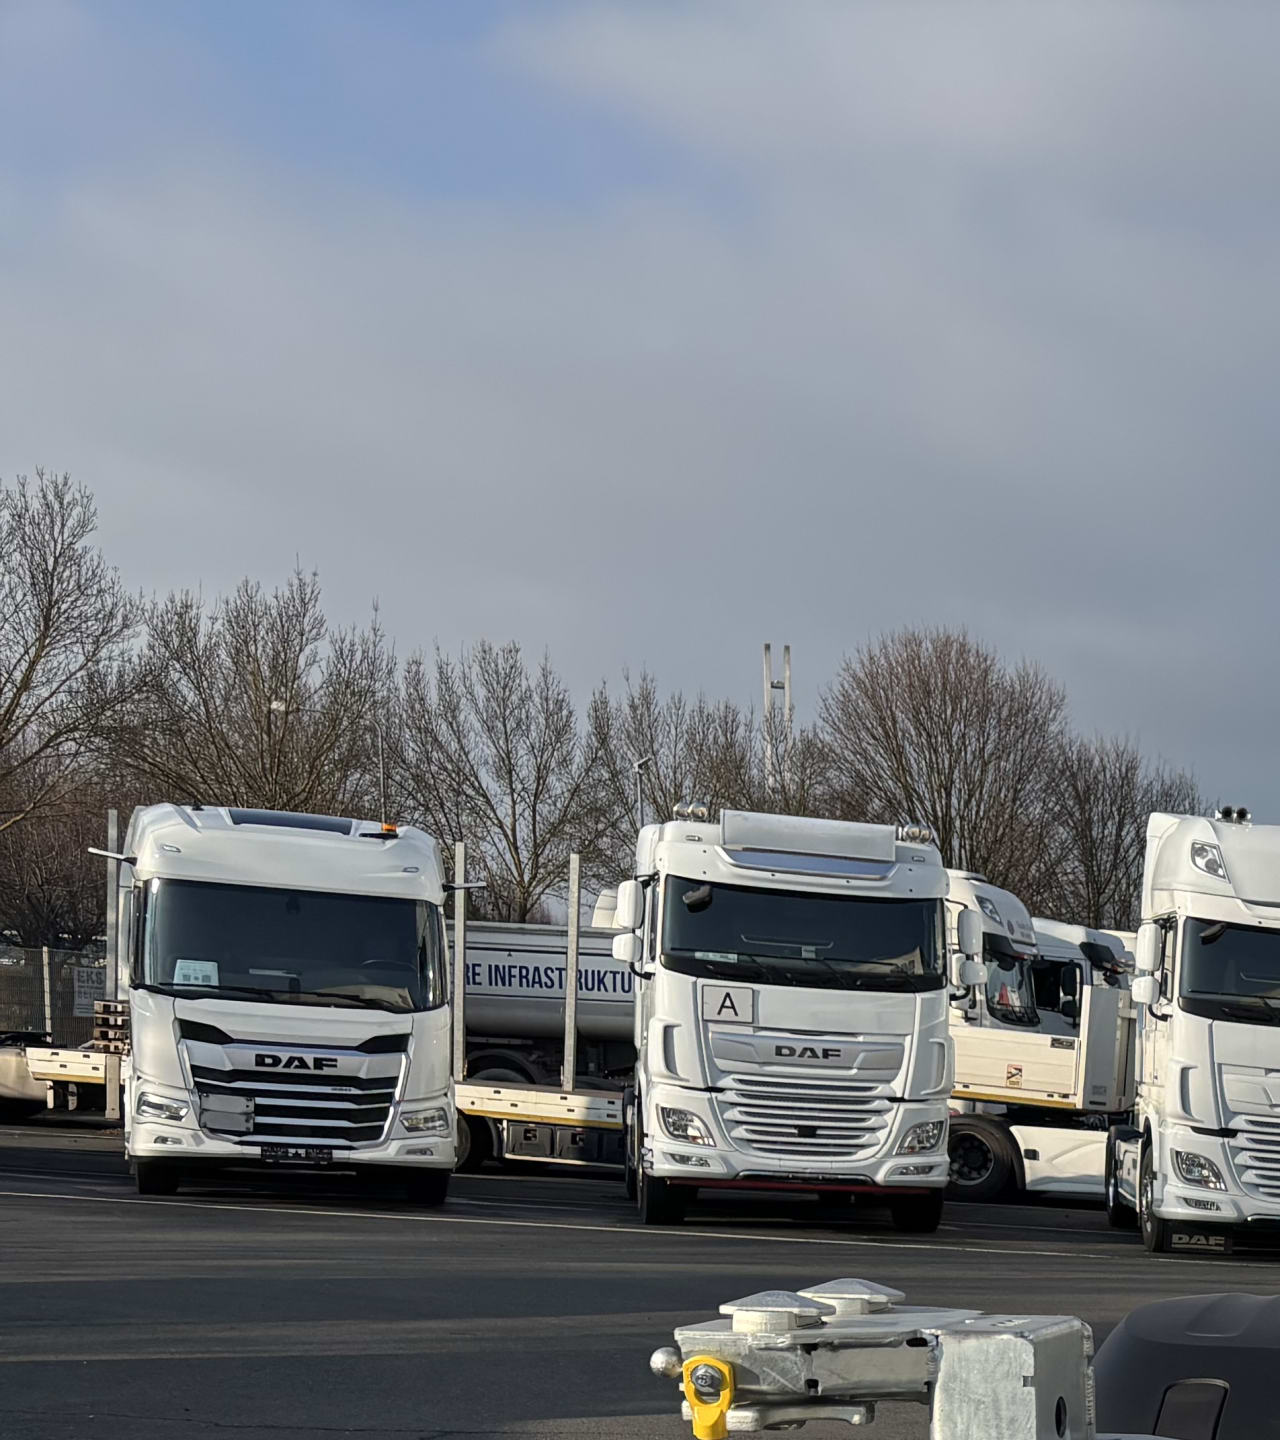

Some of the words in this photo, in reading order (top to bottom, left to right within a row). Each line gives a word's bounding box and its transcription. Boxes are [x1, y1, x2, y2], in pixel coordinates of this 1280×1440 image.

[717, 992, 739, 1017] A
[774, 1045, 842, 1060] DAF
[254, 1053, 339, 1071] DAF
[1171, 1234, 1225, 1246] DAF
